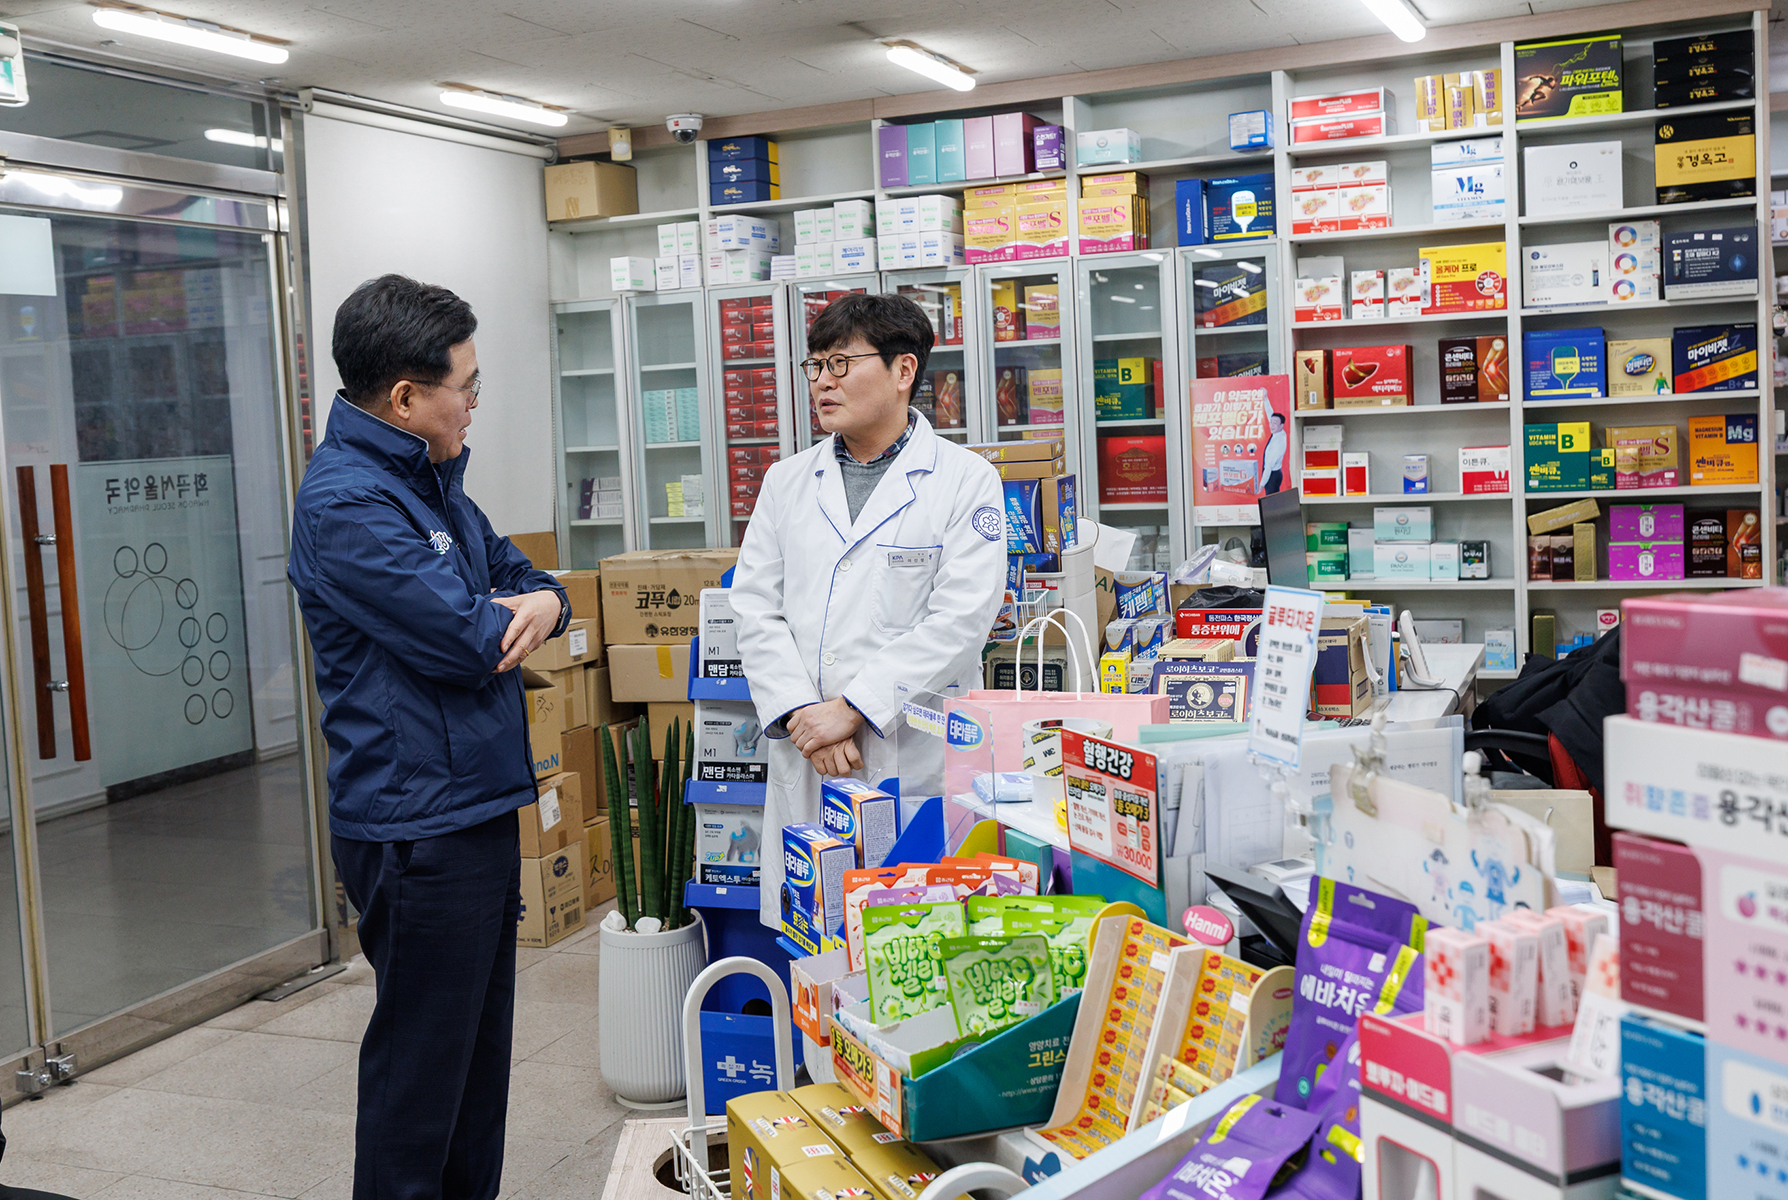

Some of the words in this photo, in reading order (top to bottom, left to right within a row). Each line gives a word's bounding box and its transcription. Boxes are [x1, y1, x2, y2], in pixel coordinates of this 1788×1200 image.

[1560, 70, 1616, 88] 파워포텐
[1460, 144, 1477, 156] Mg
[1686, 153, 1727, 167] 경옥고
[1455, 176, 1485, 195] Mg
[1688, 335, 1728, 361] 마이비젯
[1121, 368, 1132, 382] B
[1213, 391, 1225, 403] 이
[1228, 389, 1263, 402] 약국엔
[1194, 402, 1221, 413] 효과가
[1223, 401, 1252, 412] 이렇게
[1254, 401, 1263, 410] 긴
[1208, 425, 1263, 440] 있습니다
[1727, 425, 1753, 442] Mg
[1561, 434, 1574, 449] B
[1655, 438, 1670, 455] S
[1602, 456, 1610, 465] B
[635, 592, 665, 609] 코푸
[1120, 593, 1147, 618] 케펨
[1209, 614, 1232, 622] 동전파스
[1268, 606, 1315, 632] 글루타치온
[660, 627, 698, 636] 유한양행
[1191, 624, 1240, 635] 통증부위에
[708, 647, 720, 655] M1
[708, 664, 728, 676] 맨담
[1165, 665, 1215, 673] 로이히츠보코
[951, 719, 978, 742] 테라플루
[704, 748, 717, 757] M1
[1043, 748, 1056, 757] 3M
[1083, 739, 1134, 781] 혈행건강
[703, 766, 726, 779] 맨담
[1113, 799, 1124, 813] 1등
[1125, 802, 1143, 818] 오메가
[824, 806, 849, 832] 테라플루
[785, 851, 809, 879] 테라플루
[705, 874, 741, 883] 케토엑스투
[1185, 910, 1229, 941] Hanmi
[964, 957, 1037, 989] 비타C
[974, 982, 1027, 1019] 젤리
[1028, 1038, 1060, 1052] 영양치료
[831, 1025, 844, 1059] 1등
[844, 1036, 874, 1083] 오메가3
[749, 1060, 774, 1084] 녹
